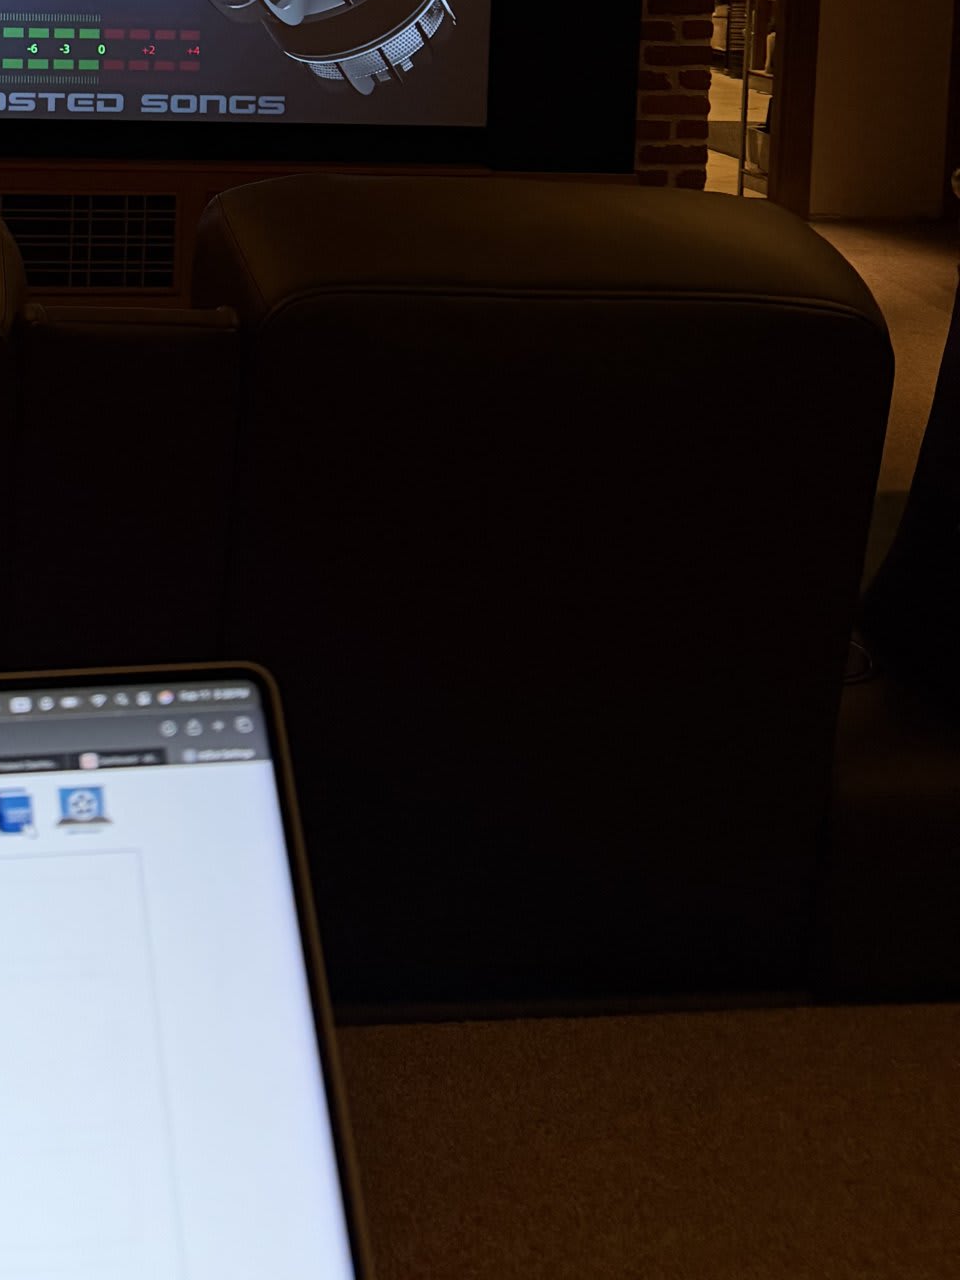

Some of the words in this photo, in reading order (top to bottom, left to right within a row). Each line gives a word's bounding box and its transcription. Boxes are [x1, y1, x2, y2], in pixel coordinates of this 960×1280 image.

[26, 43, 39, 54] -6
[58, 43, 71, 55] -3
[97, 44, 106, 56] 0
[142, 45, 157, 56] +2
[186, 46, 201, 56] +4
[140, 93, 286, 115] SONGS
